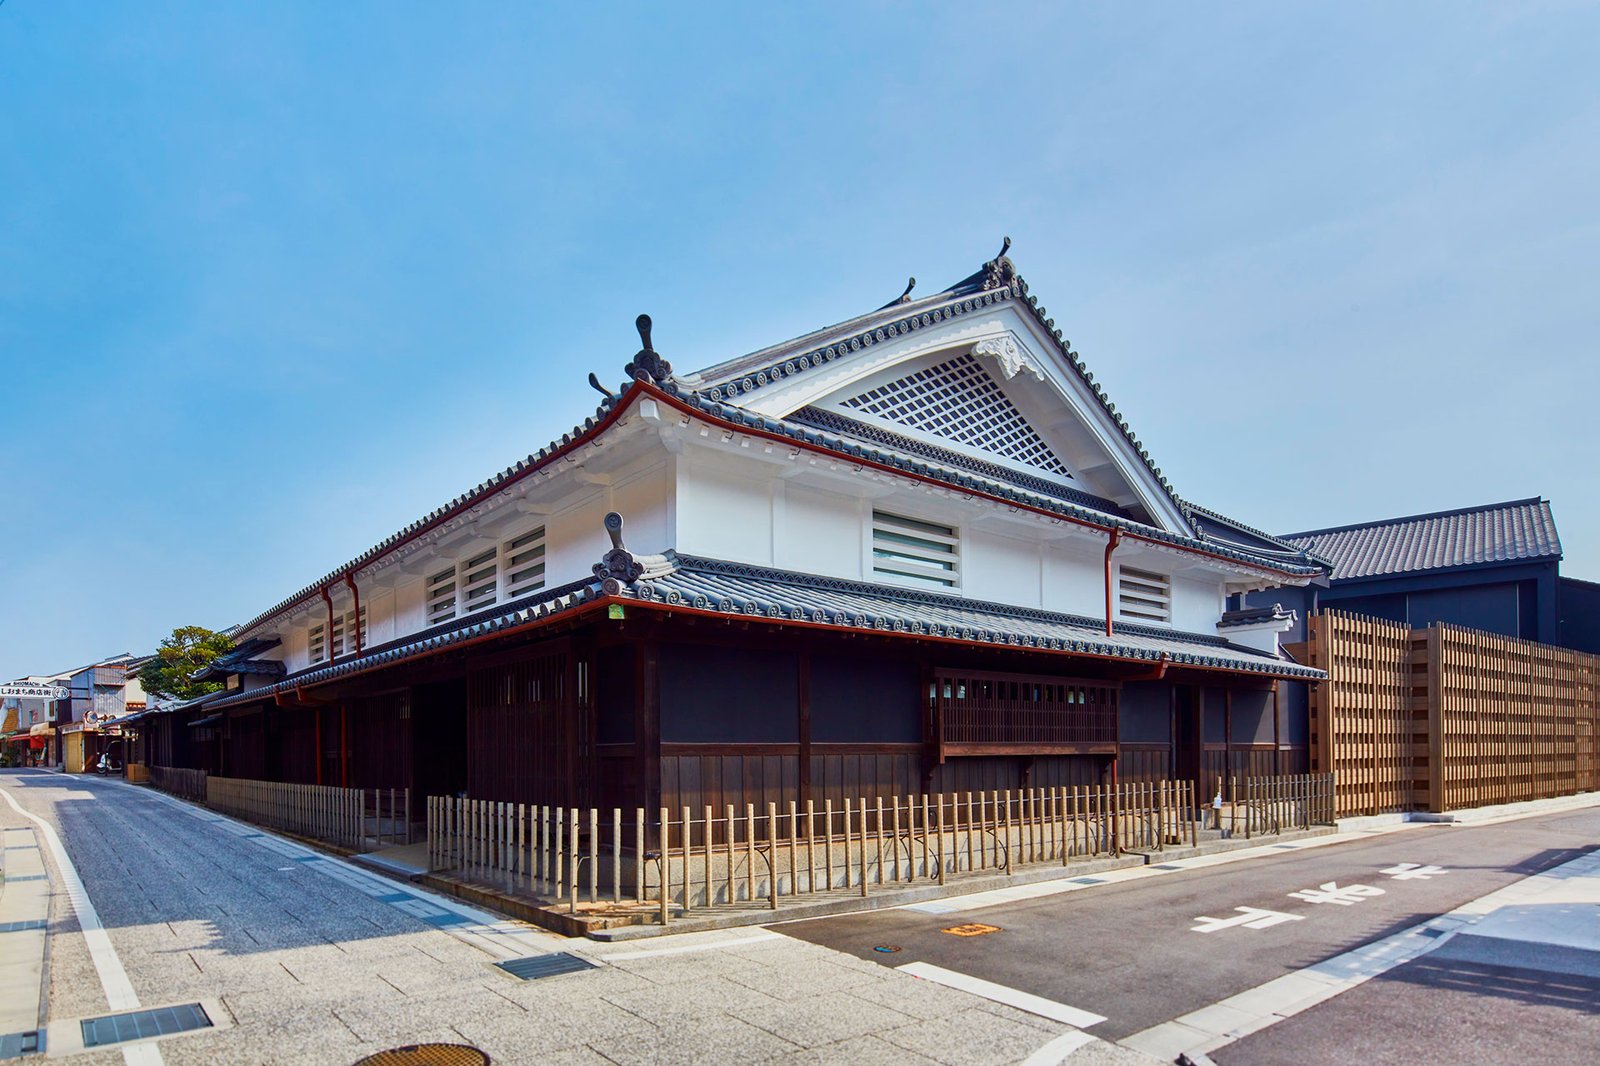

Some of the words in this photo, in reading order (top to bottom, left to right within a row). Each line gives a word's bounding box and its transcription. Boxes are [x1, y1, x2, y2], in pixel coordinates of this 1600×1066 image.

[1, 688, 52, 696] しおまち商店街
[1191, 863, 1449, 934] 止まれ
